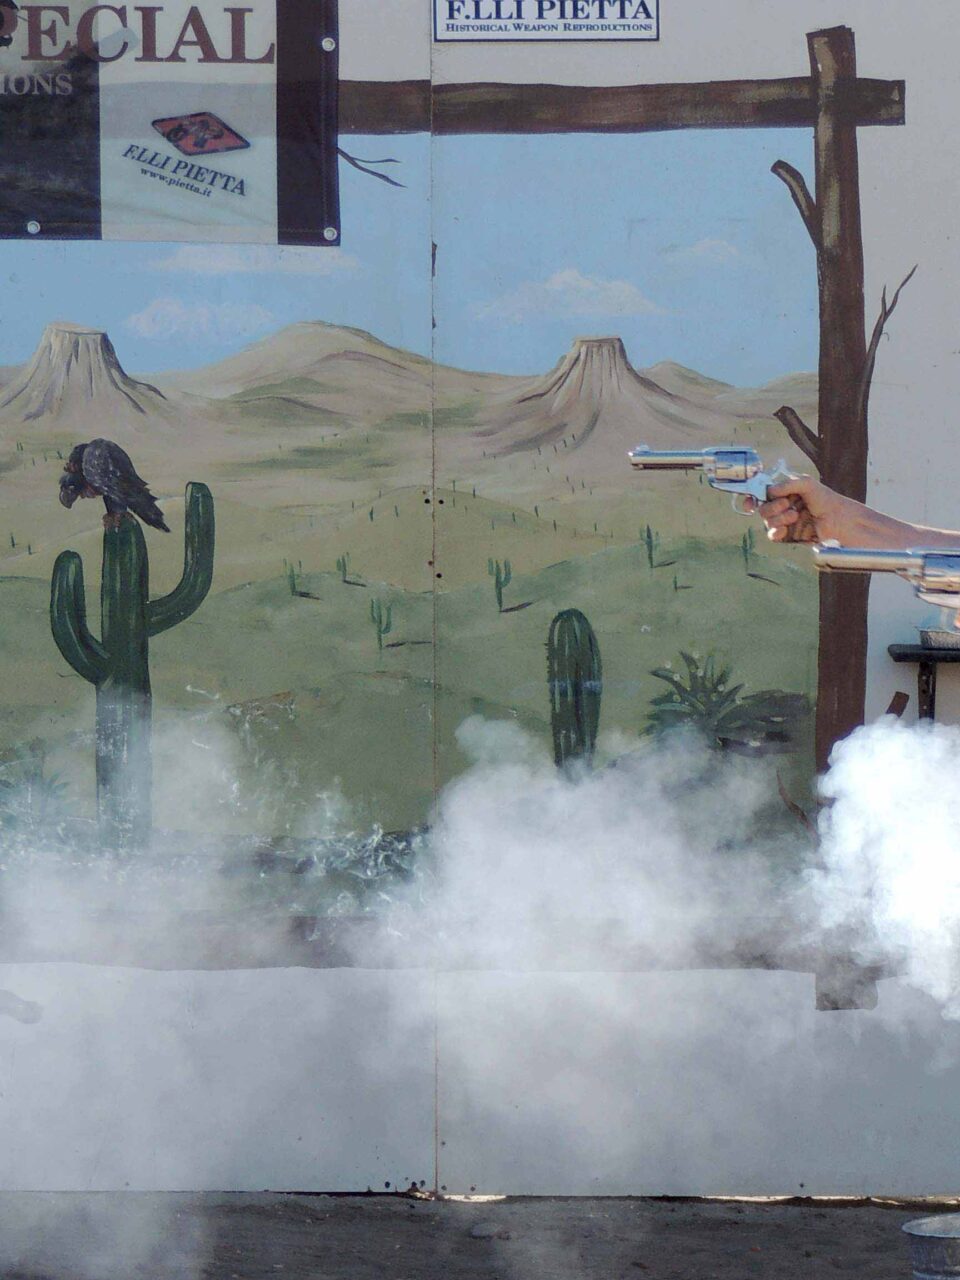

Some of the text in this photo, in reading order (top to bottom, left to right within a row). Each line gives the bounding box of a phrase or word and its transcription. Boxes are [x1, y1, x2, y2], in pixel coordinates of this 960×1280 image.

[446, 0, 655, 20] F.LLI PIETTA
[140, 167, 213, 198] www.pietta.it
[172, 159, 246, 197] PIETTA
